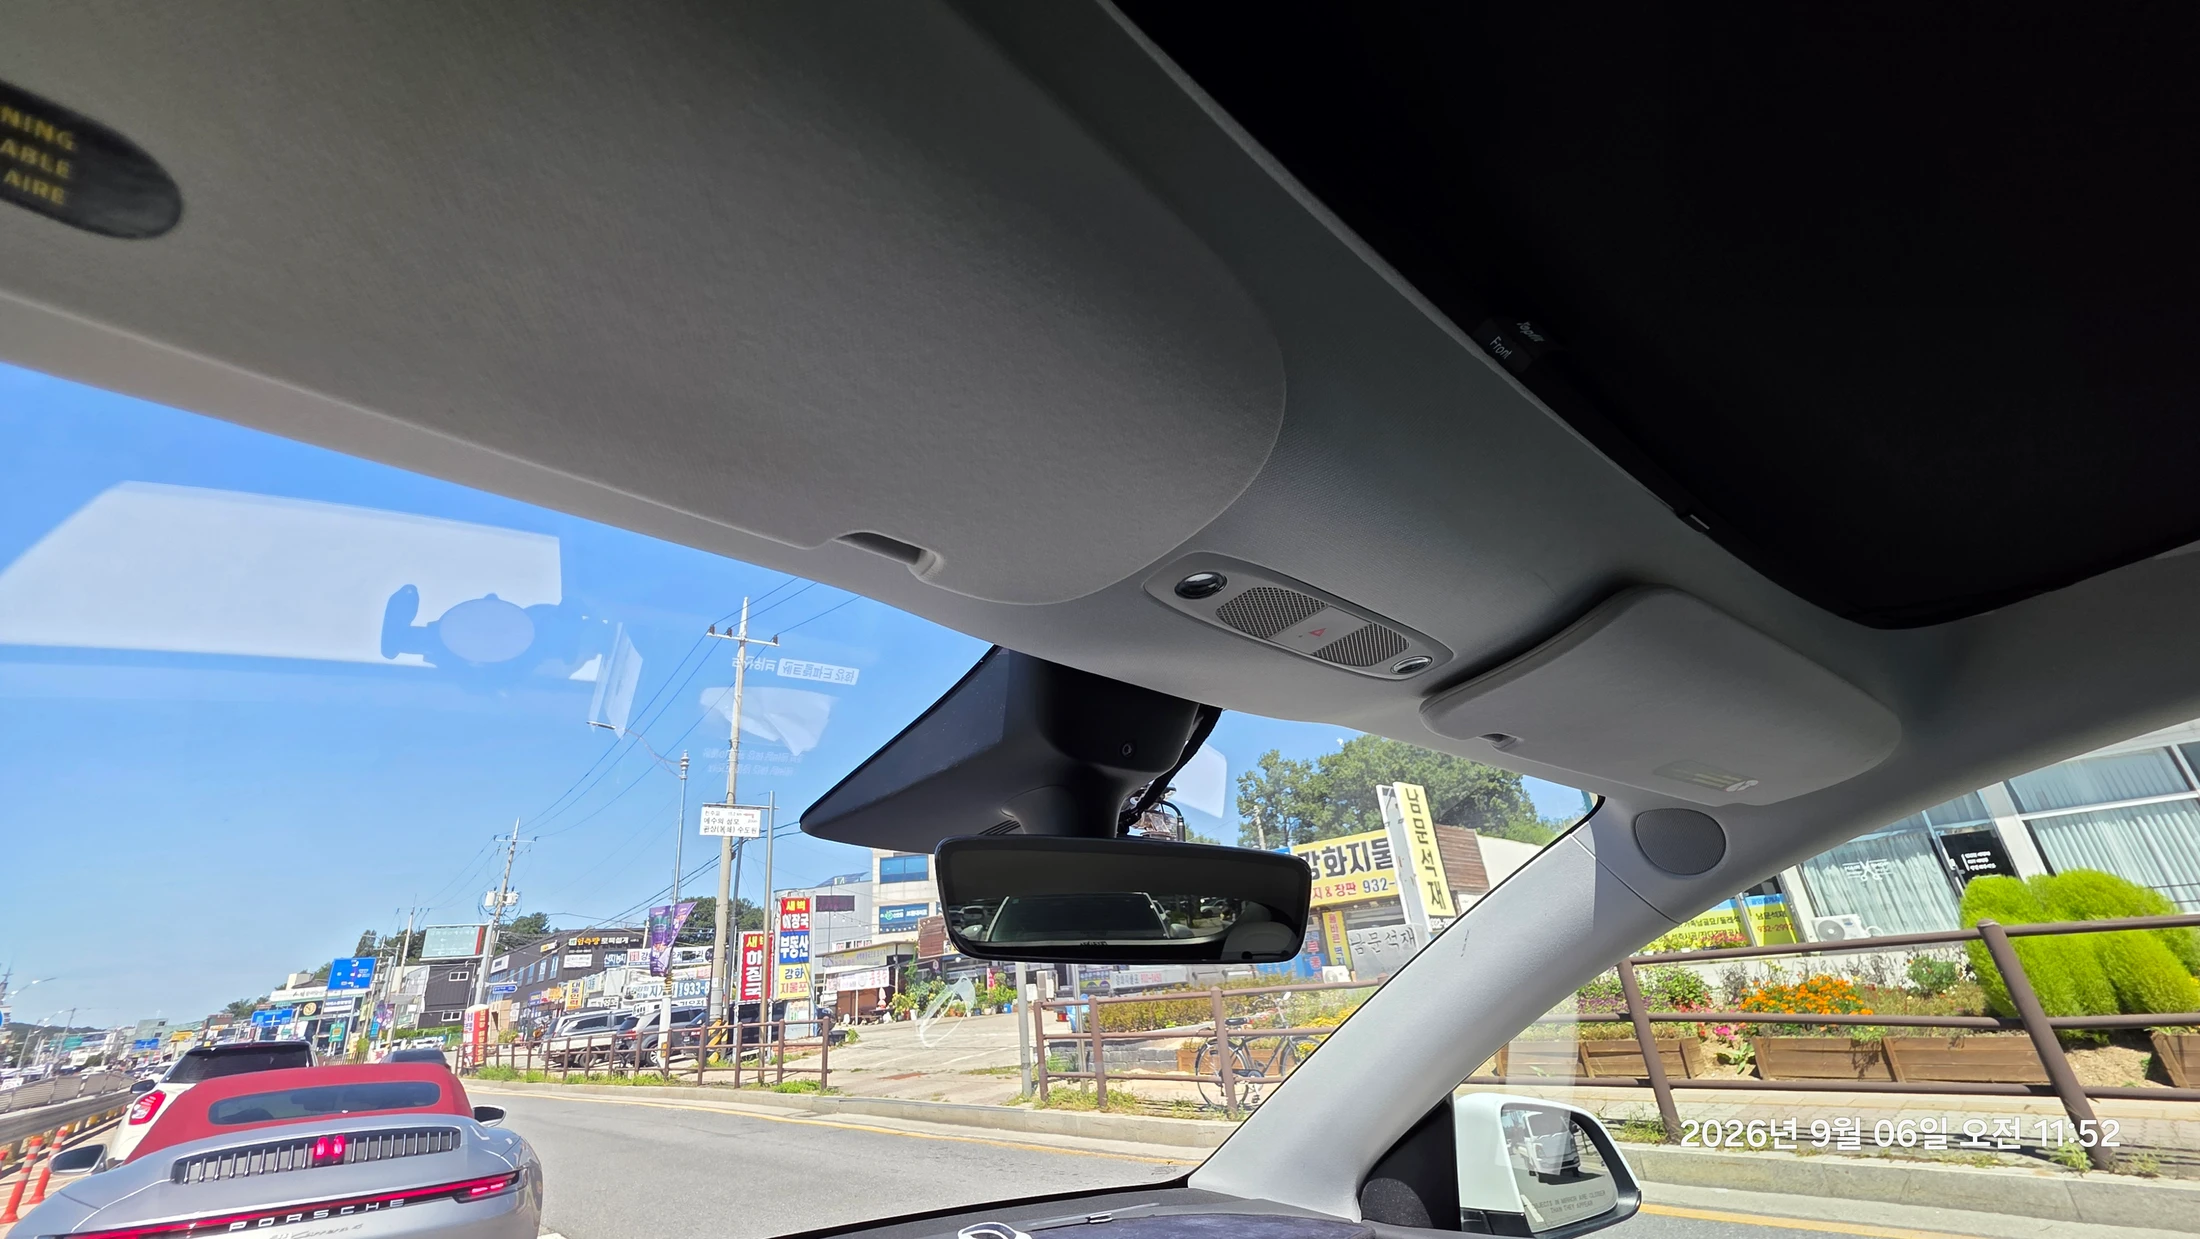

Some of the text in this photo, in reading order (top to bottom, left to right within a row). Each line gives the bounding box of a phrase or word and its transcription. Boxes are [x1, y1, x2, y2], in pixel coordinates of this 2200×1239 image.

[0, 105, 75, 151] NING
[0, 138, 71, 179] ABLE
[1489, 335, 1513, 360] Front
[1297, 836, 1395, 881] 강화지물
[1404, 787, 1448, 911] 남문석재
[1334, 881, 1357, 898] 장판
[1362, 877, 1396, 894] 932-
[786, 899, 806, 911] 새벽
[780, 935, 809, 960] 부동산
[1349, 926, 1417, 956] 남문석재
[784, 967, 805, 980] 강화
[684, 981, 710, 996] 933-8
[780, 981, 808, 995] 지물포
[1578, 1193, 1588, 1201] ARE
[228, 1198, 405, 1232] PORSCHE
